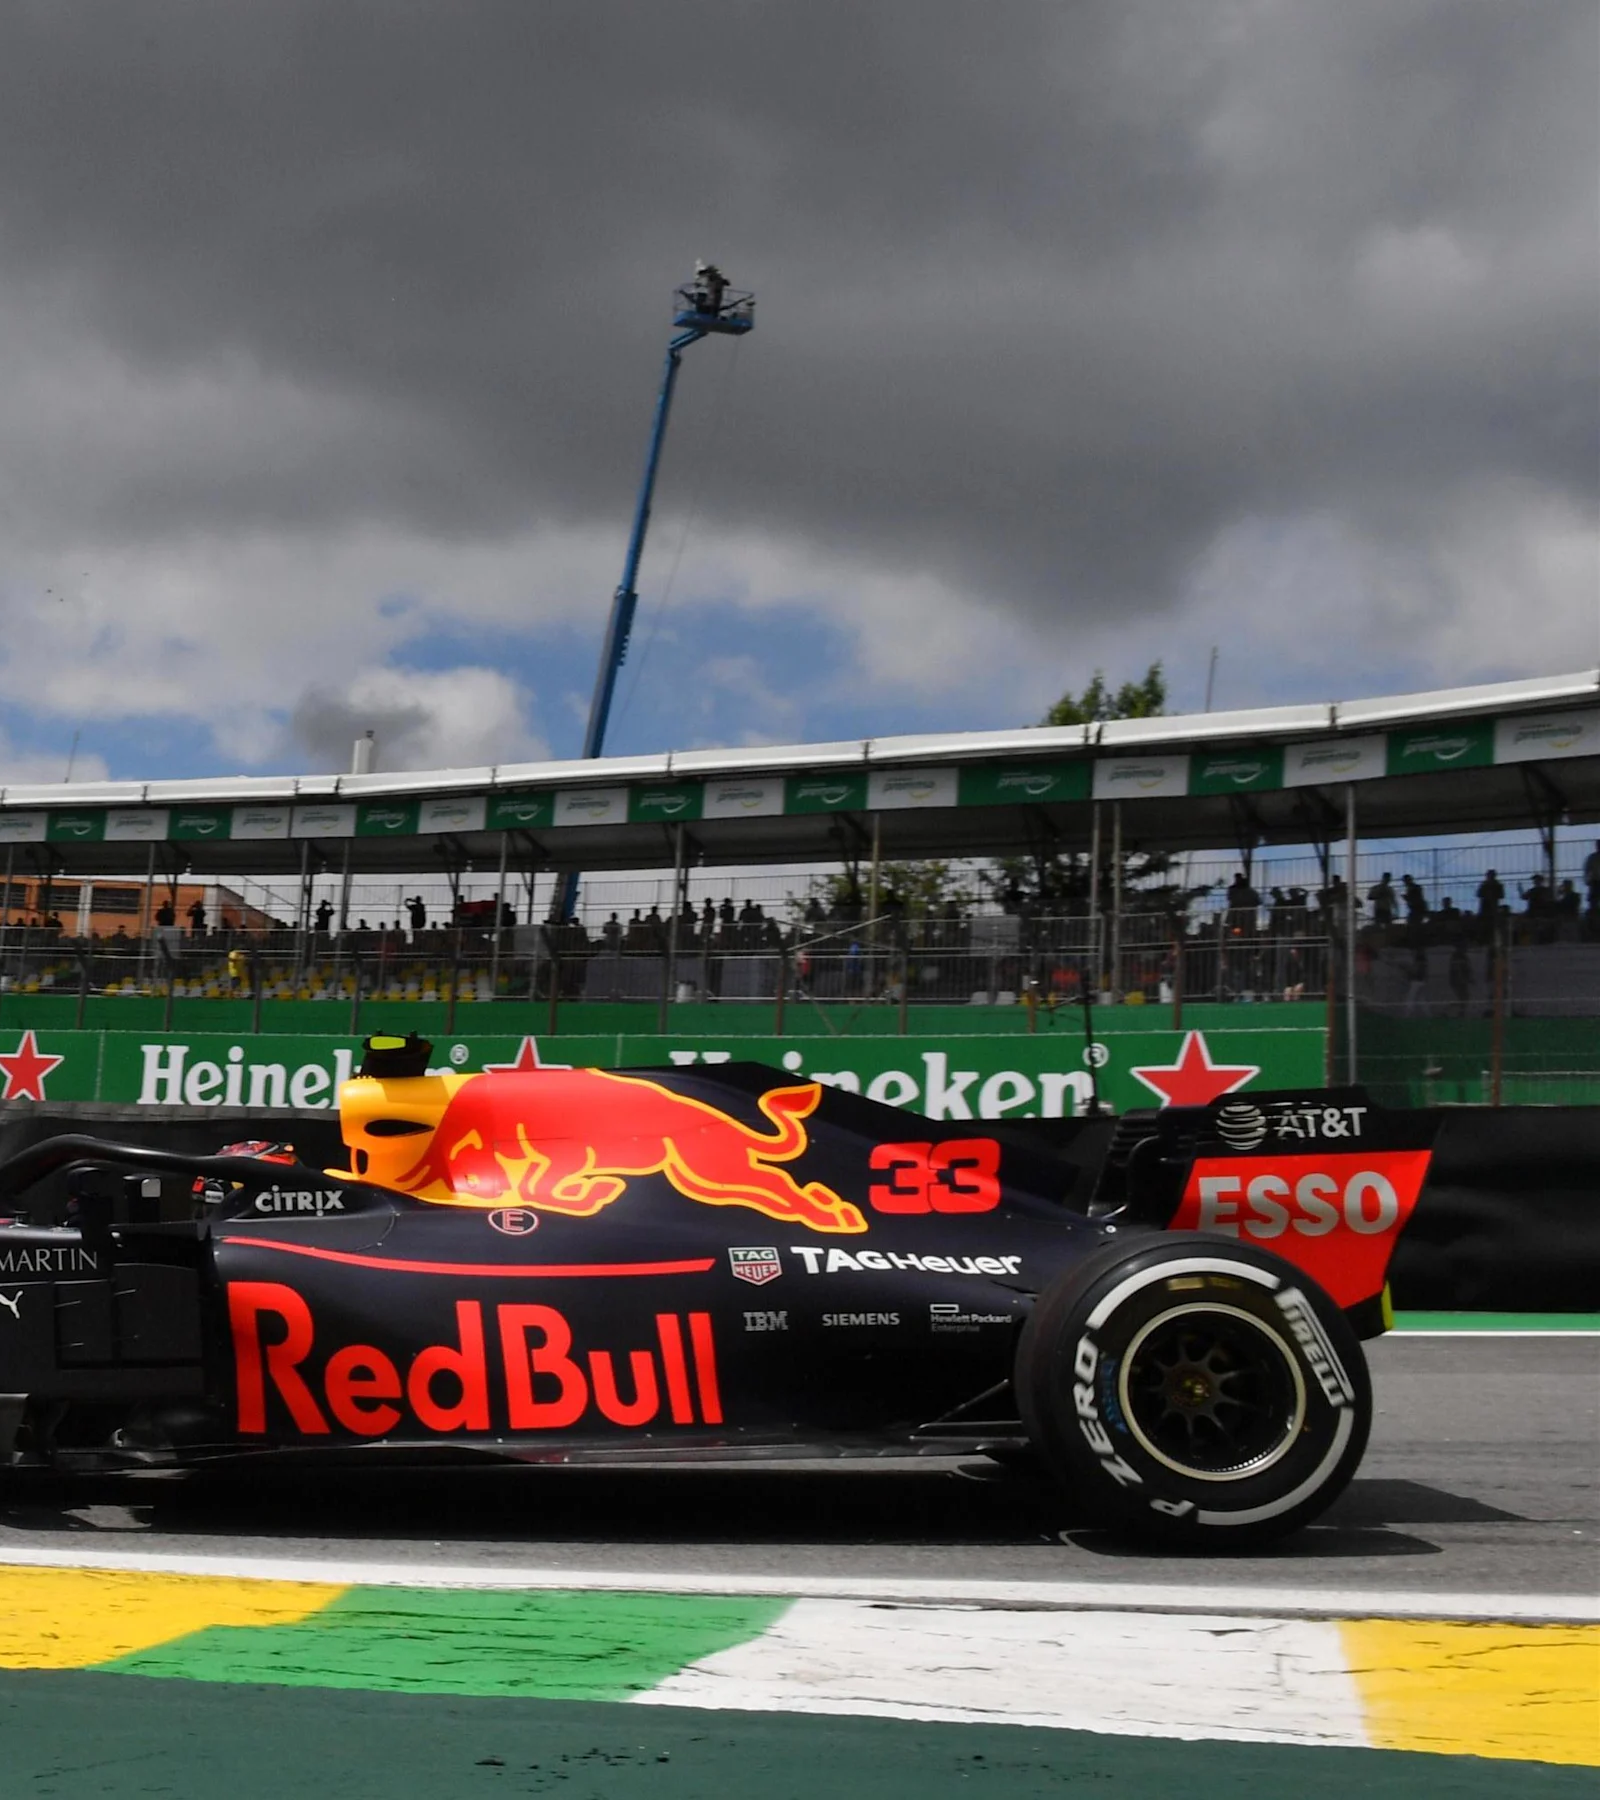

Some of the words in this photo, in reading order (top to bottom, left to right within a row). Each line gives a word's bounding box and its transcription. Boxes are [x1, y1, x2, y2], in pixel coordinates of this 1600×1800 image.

[137, 1044, 456, 1110] Heinek
[1274, 1106, 1368, 1139] AT&T
[869, 1138, 1001, 1214] 33
[1199, 1171, 1399, 1240] ESSO
[731, 1262, 781, 1279] HEUER
[732, 1250, 775, 1261] TAG
[743, 1310, 789, 1331] IBM
[822, 1311, 900, 1327] SIEMENS
[930, 1313, 970, 1324] Hewlett
[971, 1313, 1013, 1324] Packard
[1275, 1286, 1355, 1407] PIRELLI
[1073, 1331, 1144, 1488] ZERO
